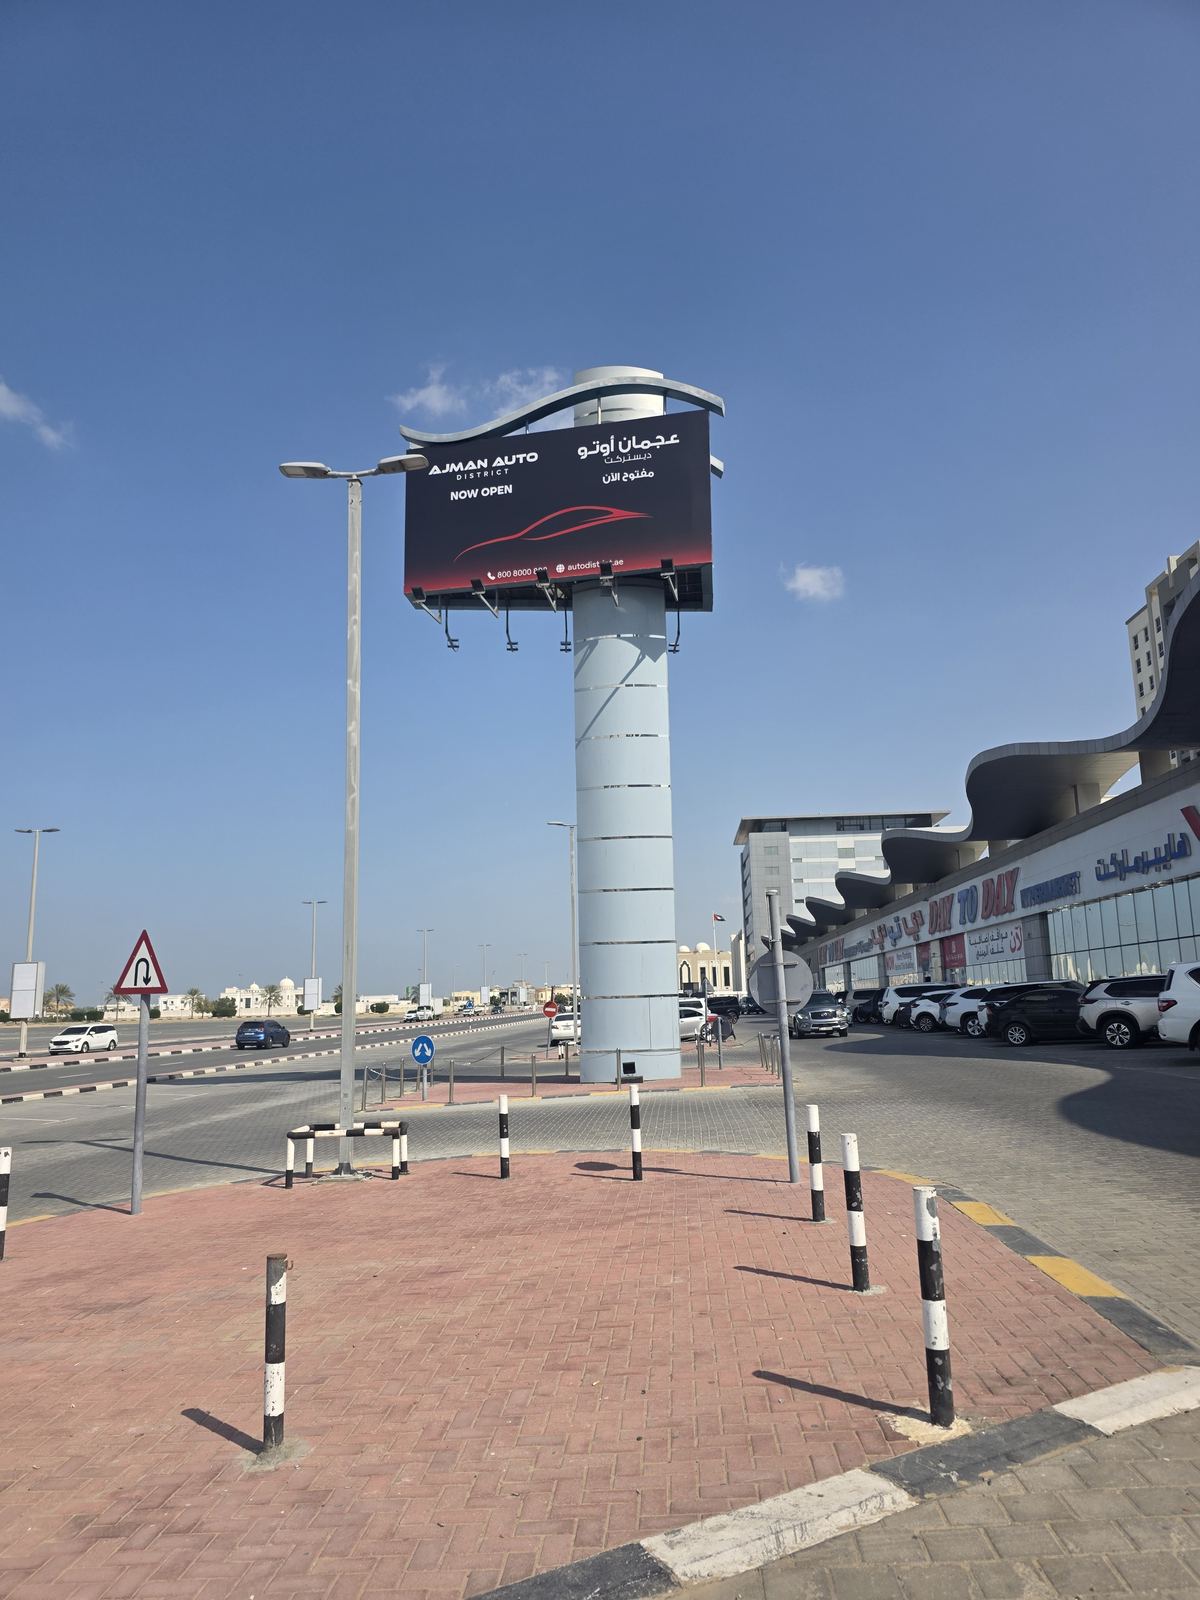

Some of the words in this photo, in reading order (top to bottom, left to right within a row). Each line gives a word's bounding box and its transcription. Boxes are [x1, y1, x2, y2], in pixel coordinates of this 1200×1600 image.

[577, 435, 615, 460] أوتو
[618, 432, 680, 453] عجمان
[428, 454, 489, 476] AJMAN
[491, 451, 539, 468] AUTO
[604, 451, 652, 465] ديستركت
[456, 468, 510, 481] DISTRICT
[602, 470, 621, 485] الآن
[622, 469, 655, 483] مفتوح
[450, 487, 479, 501] NOW
[481, 484, 513, 498] OPEN
[497, 569, 512, 579] 800
[512, 567, 532, 578] 8000
[567, 559, 624, 572] autodist.ae
[928, 893, 954, 935] DAY
[958, 885, 979, 925] TO
[981, 866, 1020, 921] DAY
